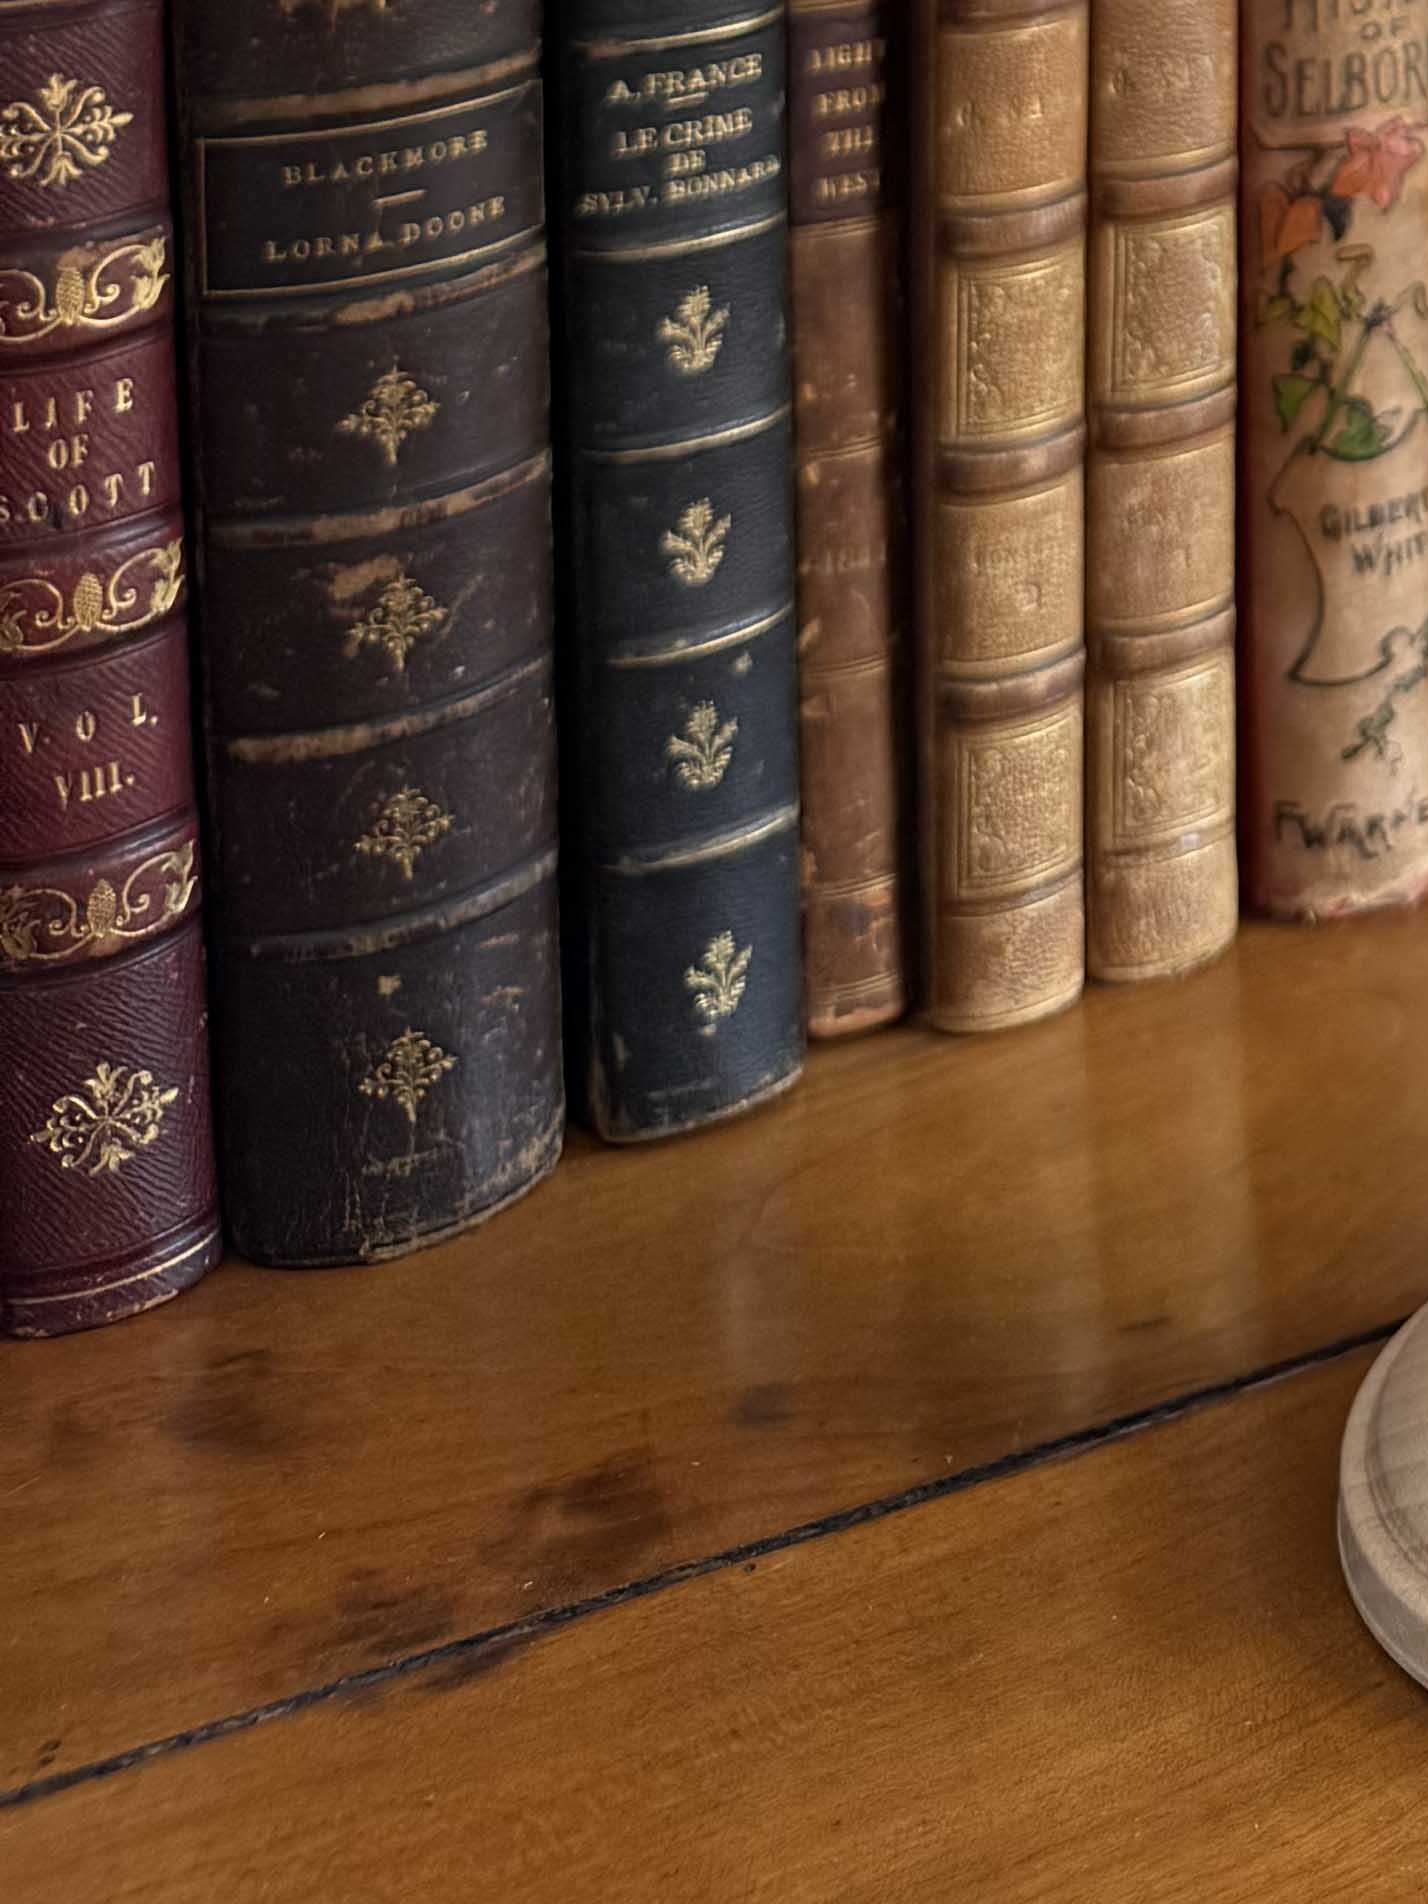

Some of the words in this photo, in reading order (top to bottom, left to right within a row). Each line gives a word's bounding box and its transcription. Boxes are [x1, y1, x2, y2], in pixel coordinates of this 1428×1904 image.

[1359, 14, 1411, 42] OF
[605, 79, 641, 103] A.
[642, 53, 764, 97] FRANCE
[611, 126, 659, 157] LE
[661, 107, 754, 148] CRIME
[280, 129, 489, 187] BLACKMORE
[661, 153, 782, 201] BONNARD
[665, 149, 707, 175] DE
[262, 230, 386, 264] LORNA
[397, 194, 506, 247] DOONE
[13, 378, 134, 433] LIFE
[48, 433, 91, 469] OF
[53, 759, 136, 810] VIII.
